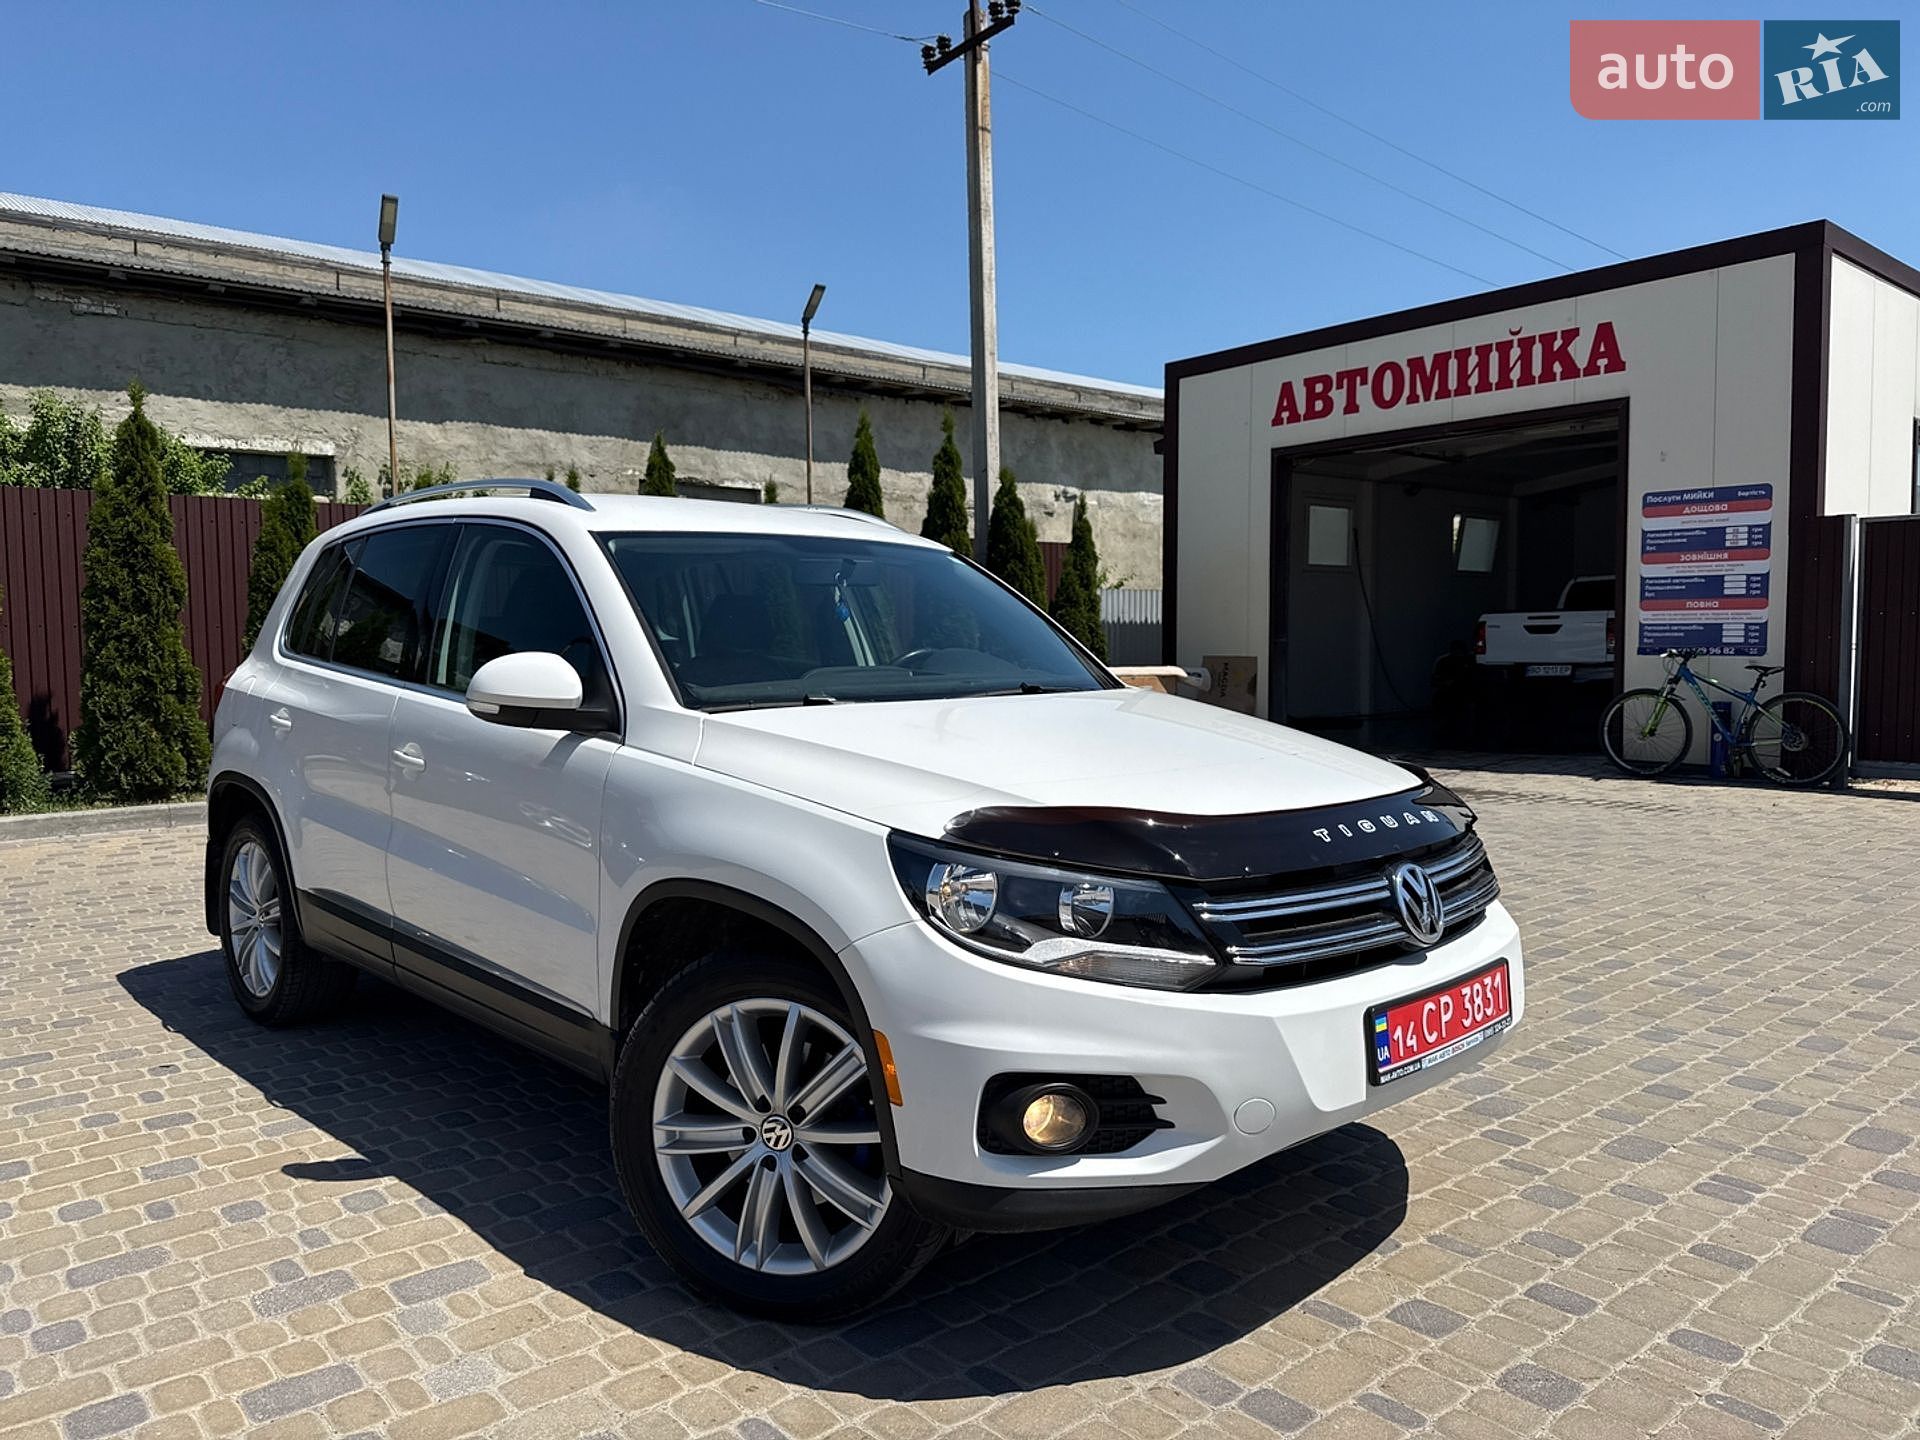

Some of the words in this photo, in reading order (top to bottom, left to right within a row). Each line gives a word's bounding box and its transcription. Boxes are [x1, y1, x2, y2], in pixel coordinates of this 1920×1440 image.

[1271, 321, 1626, 427] АВТОМИЙКА
[1313, 810, 1439, 843] TIGUAN
[1393, 1021, 1418, 1057] 14
[1422, 995, 1454, 1044] CP
[1461, 972, 1505, 1028] 3831
[1377, 1047, 1391, 1062] UA
